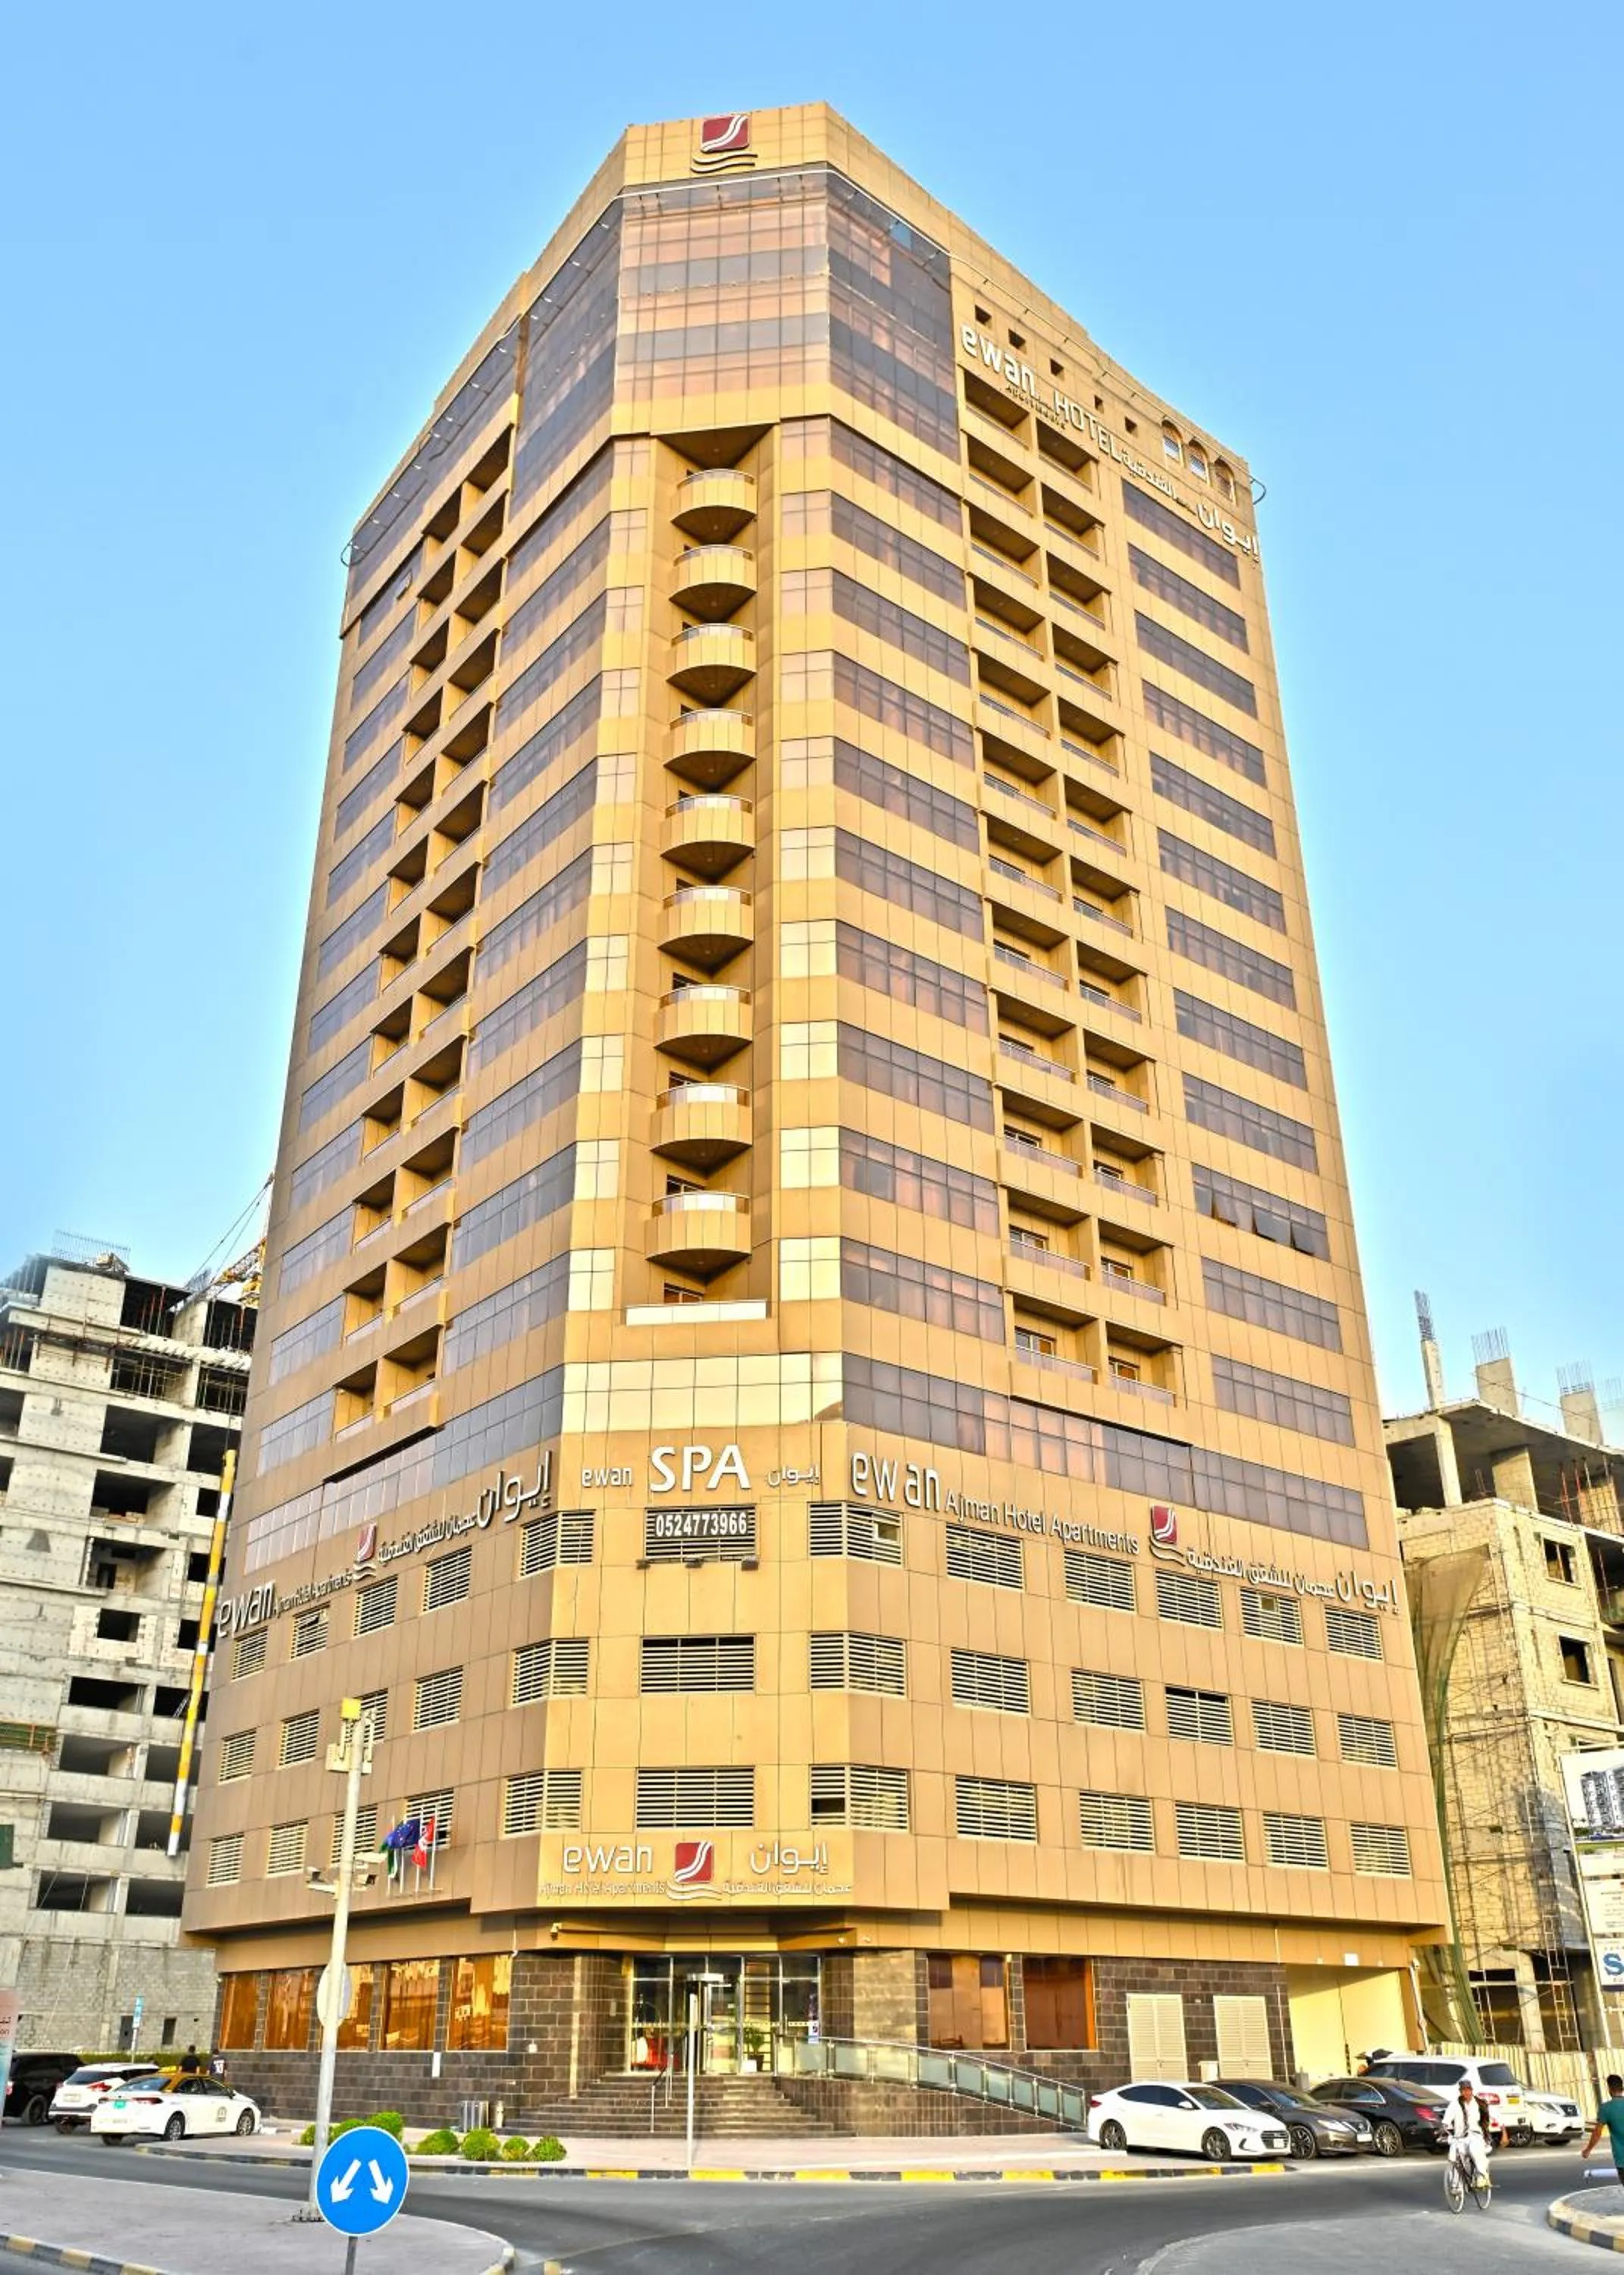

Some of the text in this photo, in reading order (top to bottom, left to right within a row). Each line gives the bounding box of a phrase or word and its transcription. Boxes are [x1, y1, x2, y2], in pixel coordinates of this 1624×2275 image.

[961, 325, 1036, 397] ewan
[1052, 389, 1122, 464] HOTEL
[476, 1450, 553, 1529] إيوان
[582, 1467, 633, 1488] ewan
[650, 1444, 751, 1493] SPA
[767, 1464, 820, 1486] إيوان
[655, 1511, 748, 1537] 0524773966
[851, 1451, 1140, 1555] ewan Ajman Hotel Apartments
[217, 1580, 275, 1639] ewan
[1335, 1570, 1399, 1614] إيوان
[563, 1844, 654, 1874] ewan
[750, 1840, 829, 1874] إيوان
